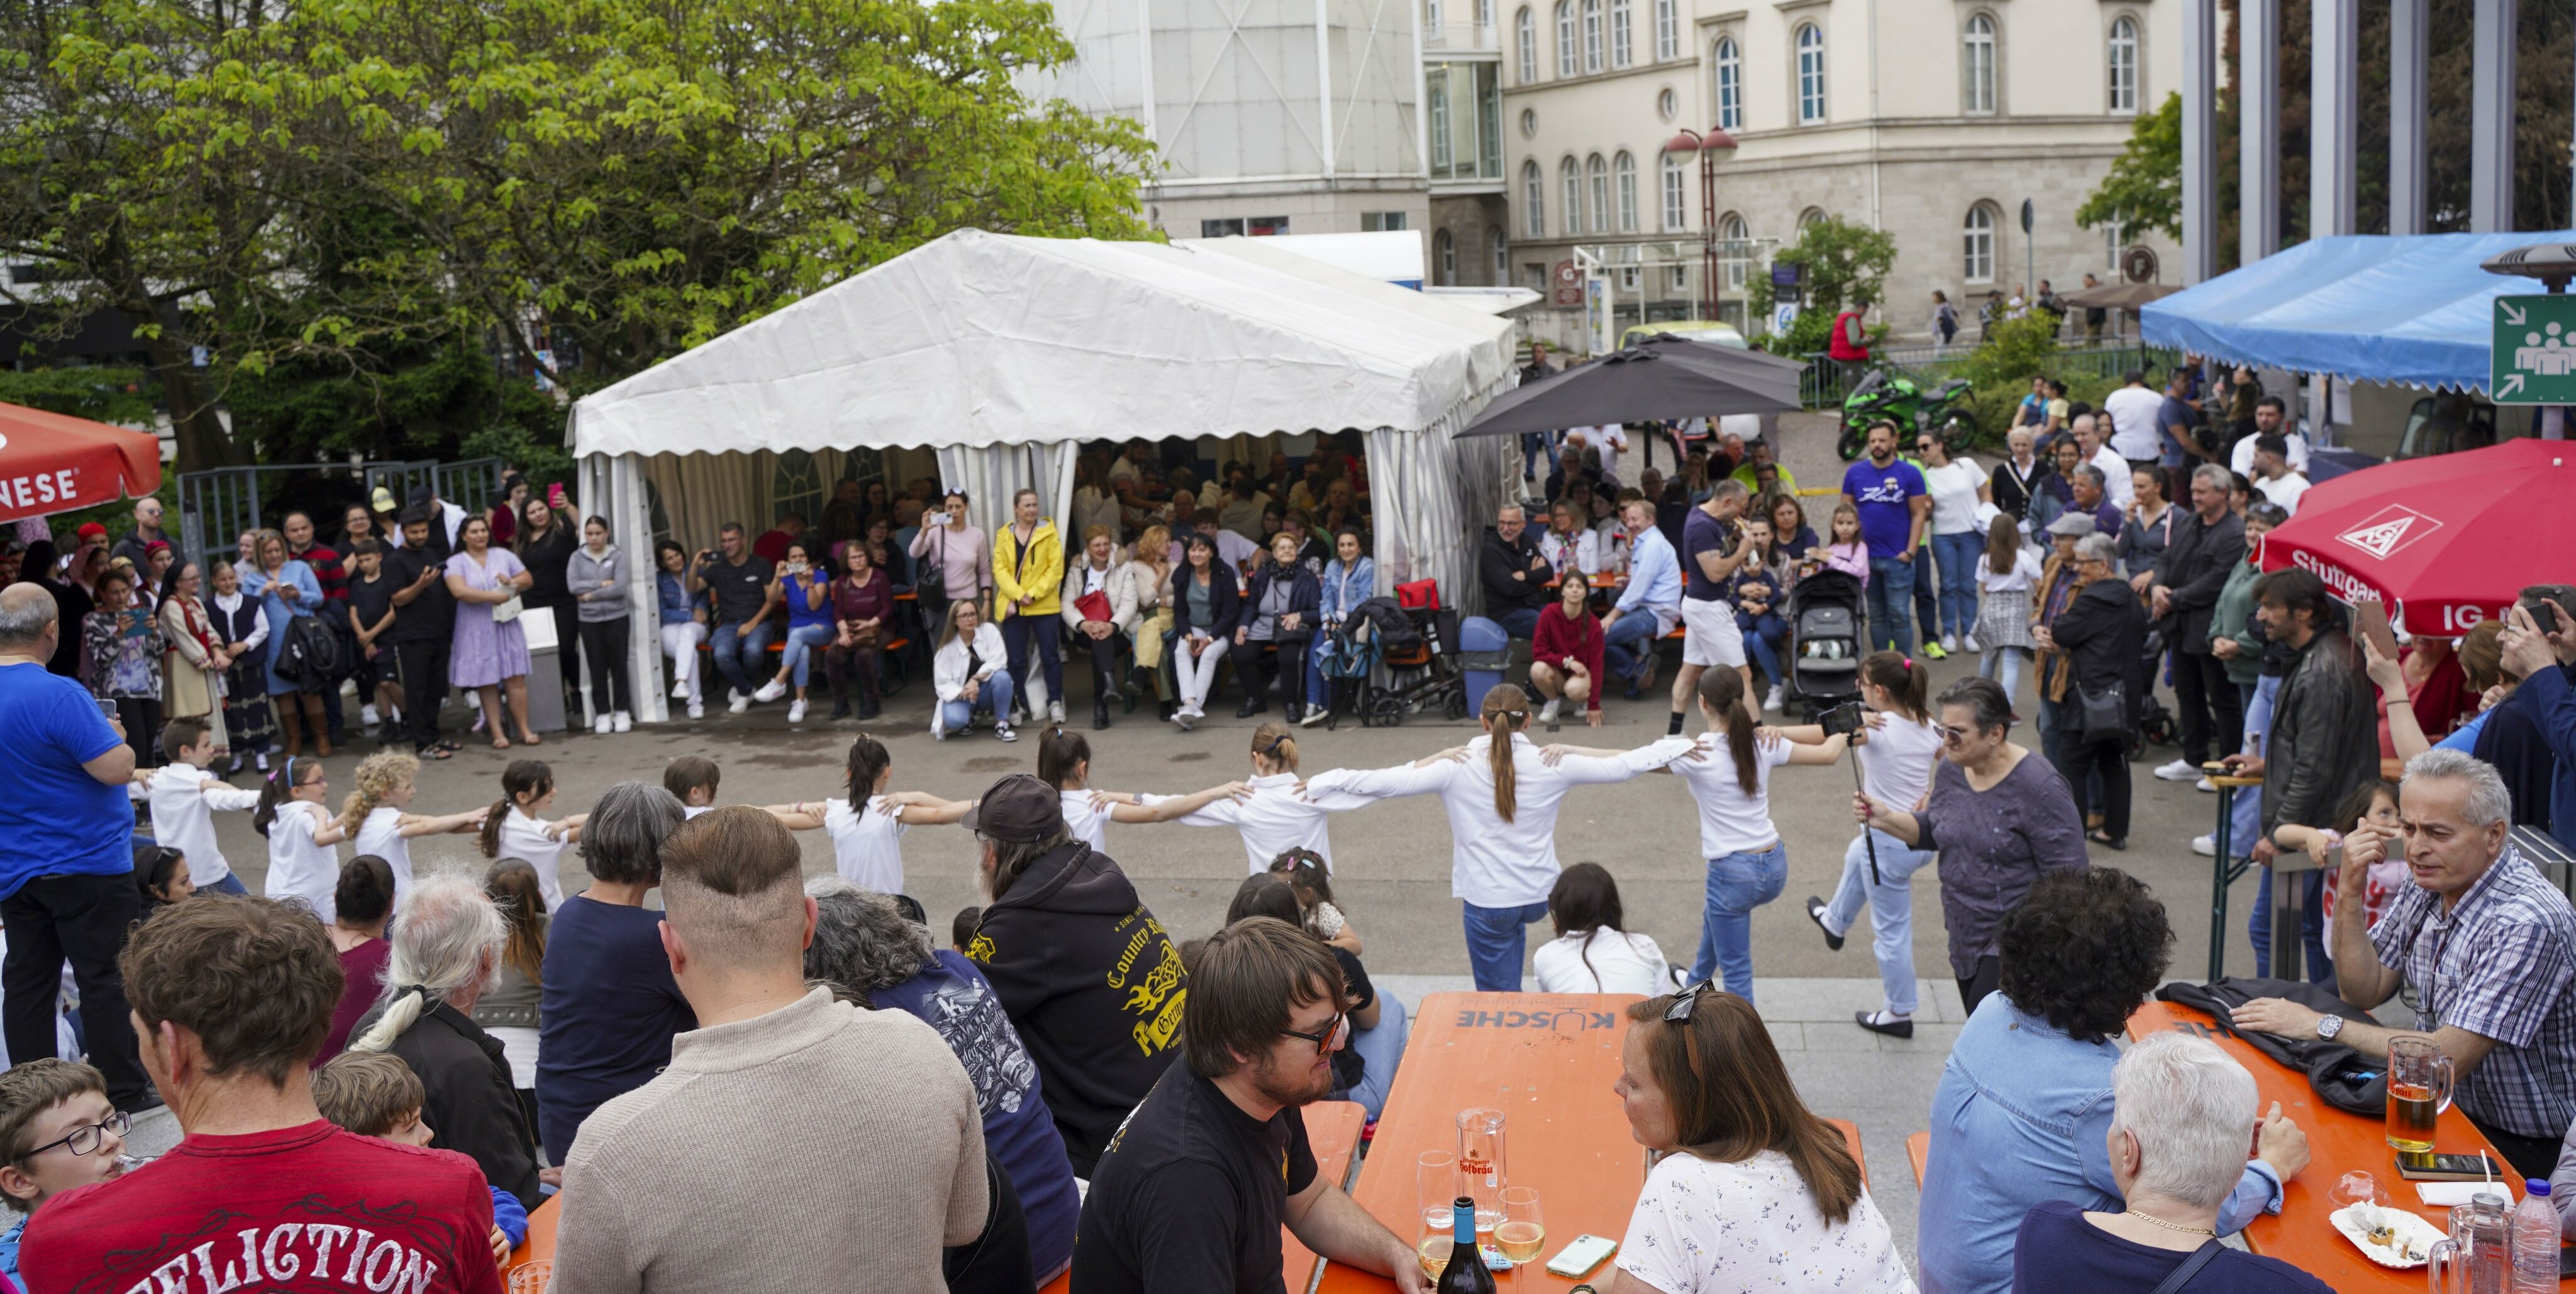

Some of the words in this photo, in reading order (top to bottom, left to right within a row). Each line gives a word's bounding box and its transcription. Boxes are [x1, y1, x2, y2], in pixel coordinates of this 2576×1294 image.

[2443, 605, 2483, 631] IG
[1119, 913, 1135, 928] SINCE
[1107, 927, 1151, 989] Country
[1157, 998, 1185, 1035] Germ
[1463, 1157, 1490, 1166] Stuttgarter
[125, 1223, 439, 1294] FLICTION
